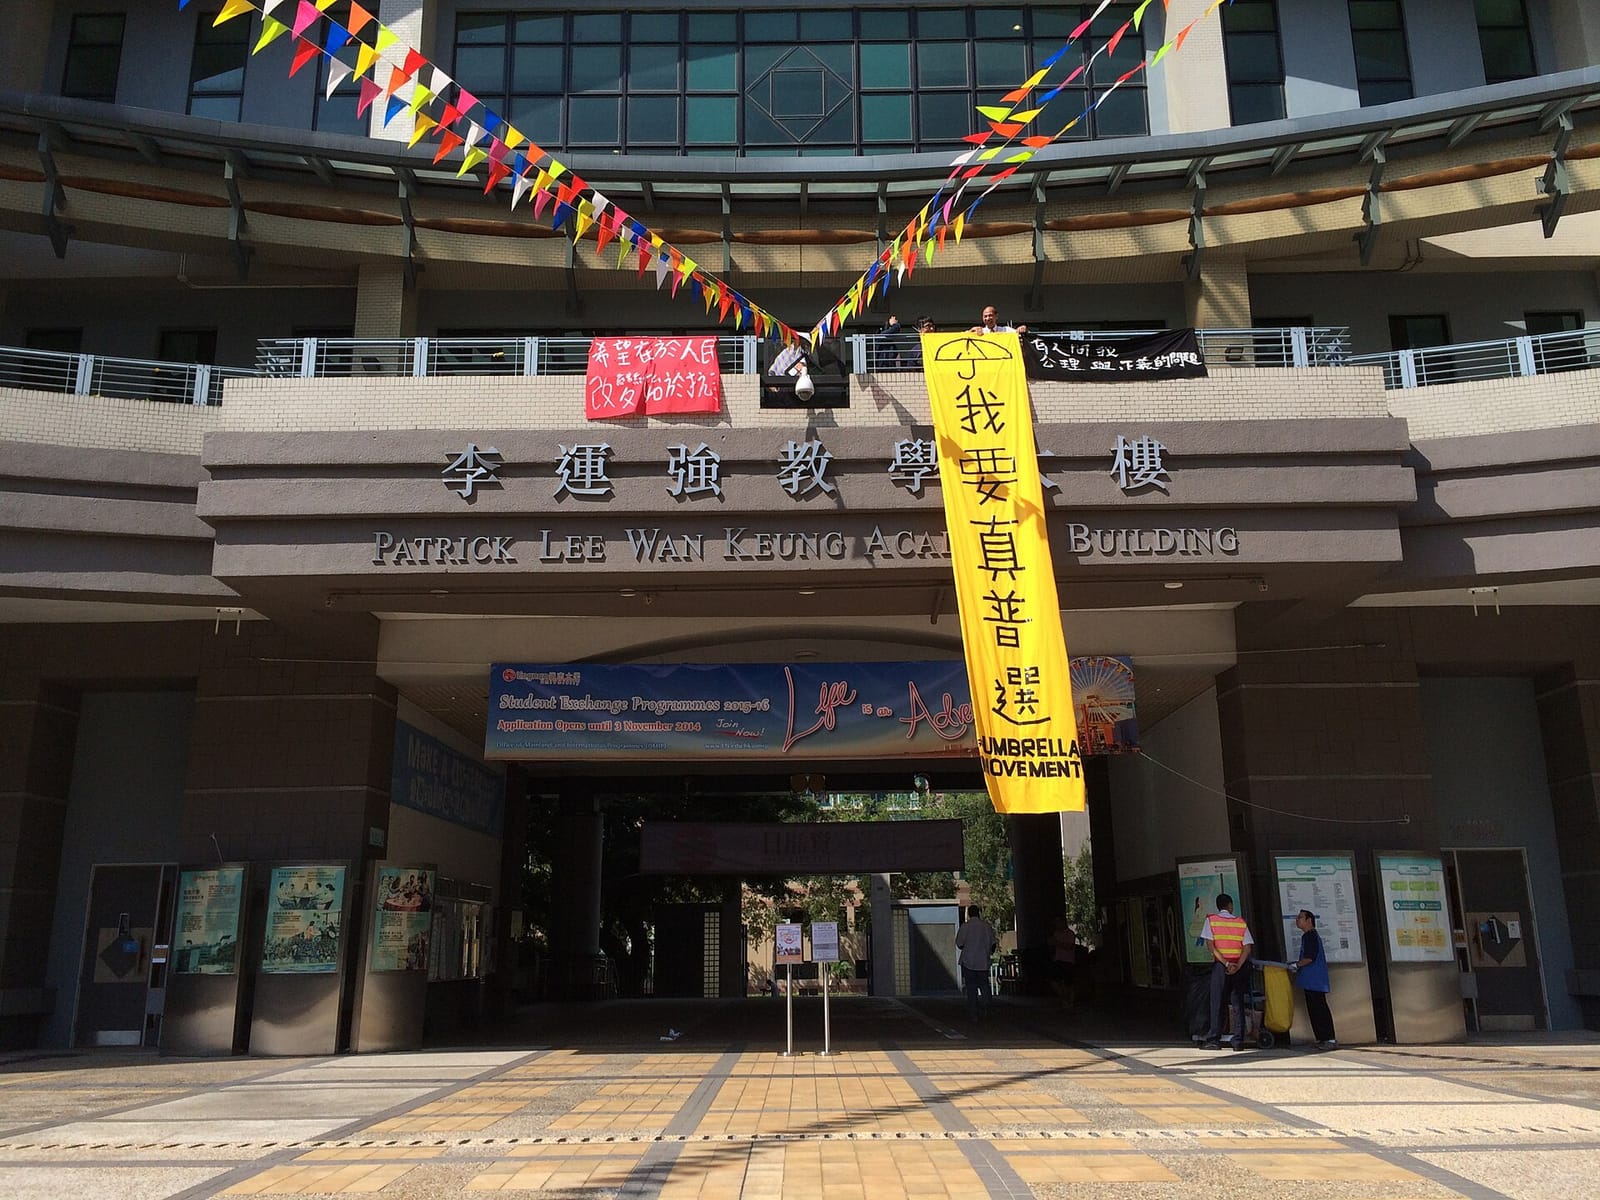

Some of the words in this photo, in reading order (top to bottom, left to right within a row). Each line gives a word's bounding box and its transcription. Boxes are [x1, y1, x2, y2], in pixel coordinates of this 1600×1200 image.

[591, 338, 716, 368] 希望在於人民
[441, 434, 1168, 498] 李運強教學樓
[956, 384, 1051, 726] 我要真普選
[499, 693, 557, 711] Student
[560, 695, 628, 714] Exchange
[632, 696, 721, 716] Programmes
[723, 698, 770, 715] 2015-16
[782, 666, 857, 752] Life
[862, 703, 873, 715] is
[876, 705, 893, 718] an
[898, 680, 974, 741] Adve
[497, 718, 553, 731] Application
[555, 719, 586, 732] Opens
[588, 719, 612, 732] until
[614, 720, 622, 732] 3
[623, 719, 673, 732] November
[674, 720, 702, 732] 2014
[715, 718, 739, 729] Join
[736, 727, 766, 738] Now!
[979, 736, 1081, 758] UMBRELLA
